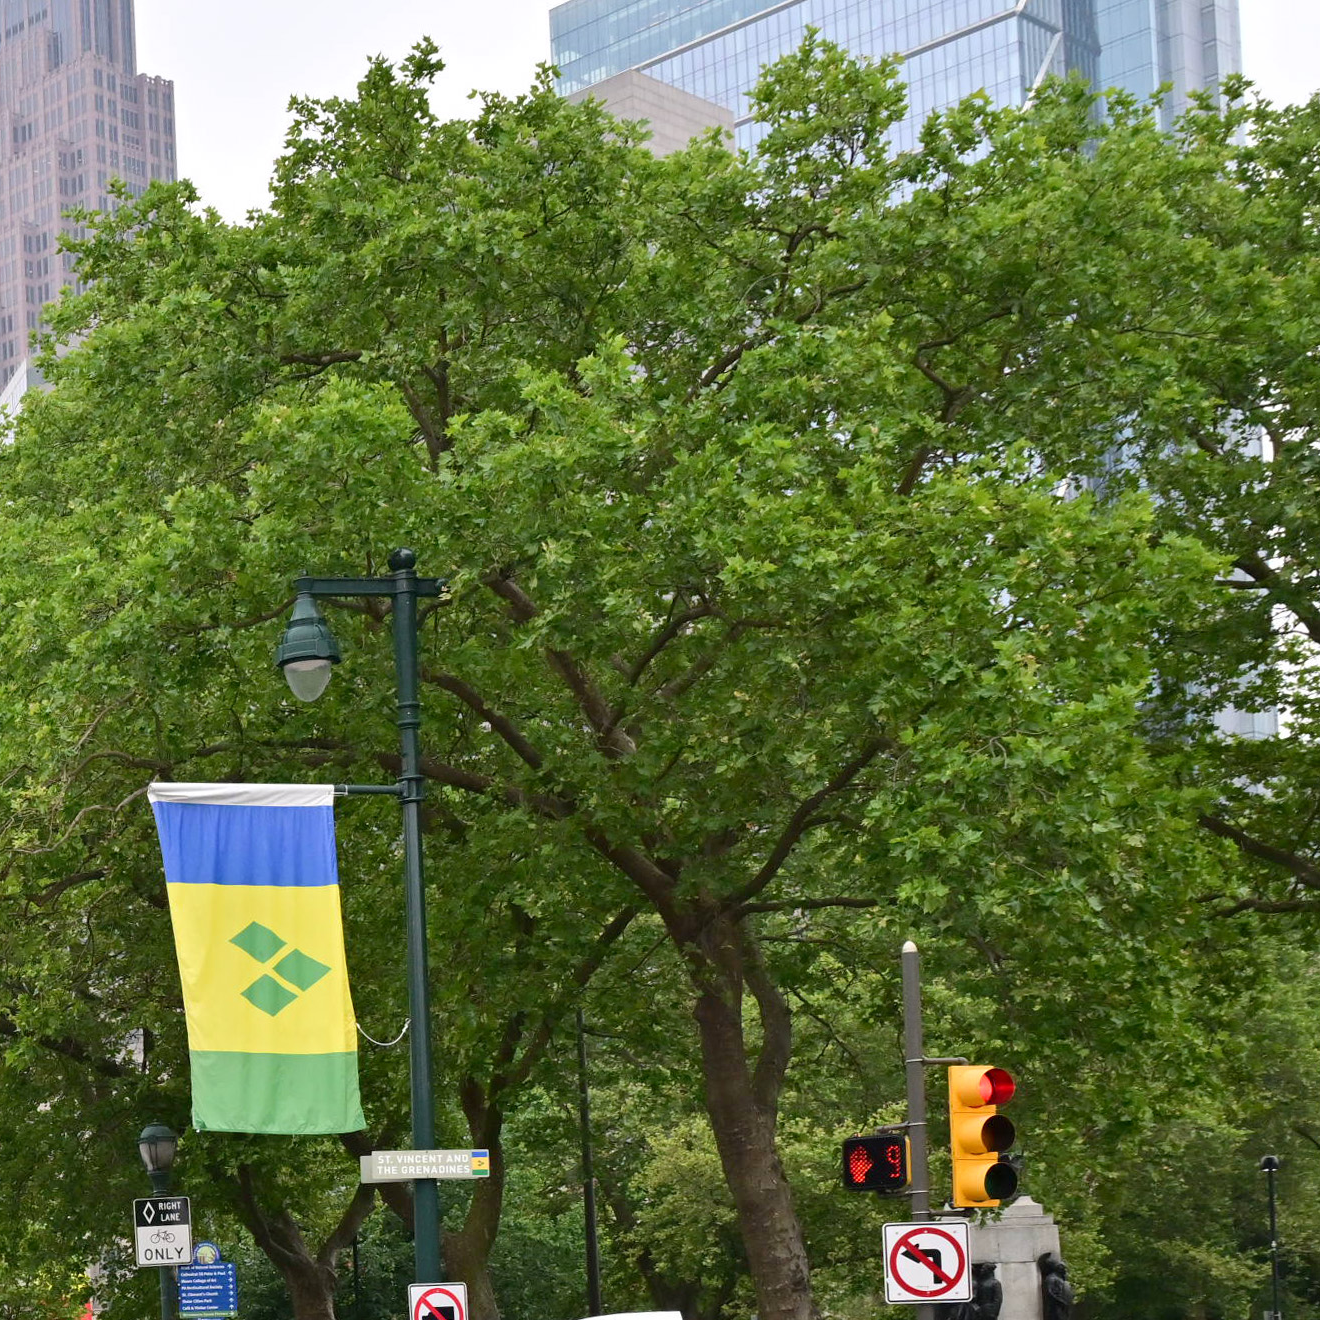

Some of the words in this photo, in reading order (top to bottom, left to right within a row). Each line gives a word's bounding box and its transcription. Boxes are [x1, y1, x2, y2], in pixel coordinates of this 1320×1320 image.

[397, 1155, 442, 1163] VINCENT
[446, 1155, 469, 1163] AND
[887, 1145, 901, 1178] 9
[378, 1166, 398, 1174] THE
[402, 1165, 470, 1174] GRENADINES
[158, 1202, 181, 1210] RIGHT
[160, 1213, 180, 1221] LANE
[144, 1248, 184, 1260] ONLY
